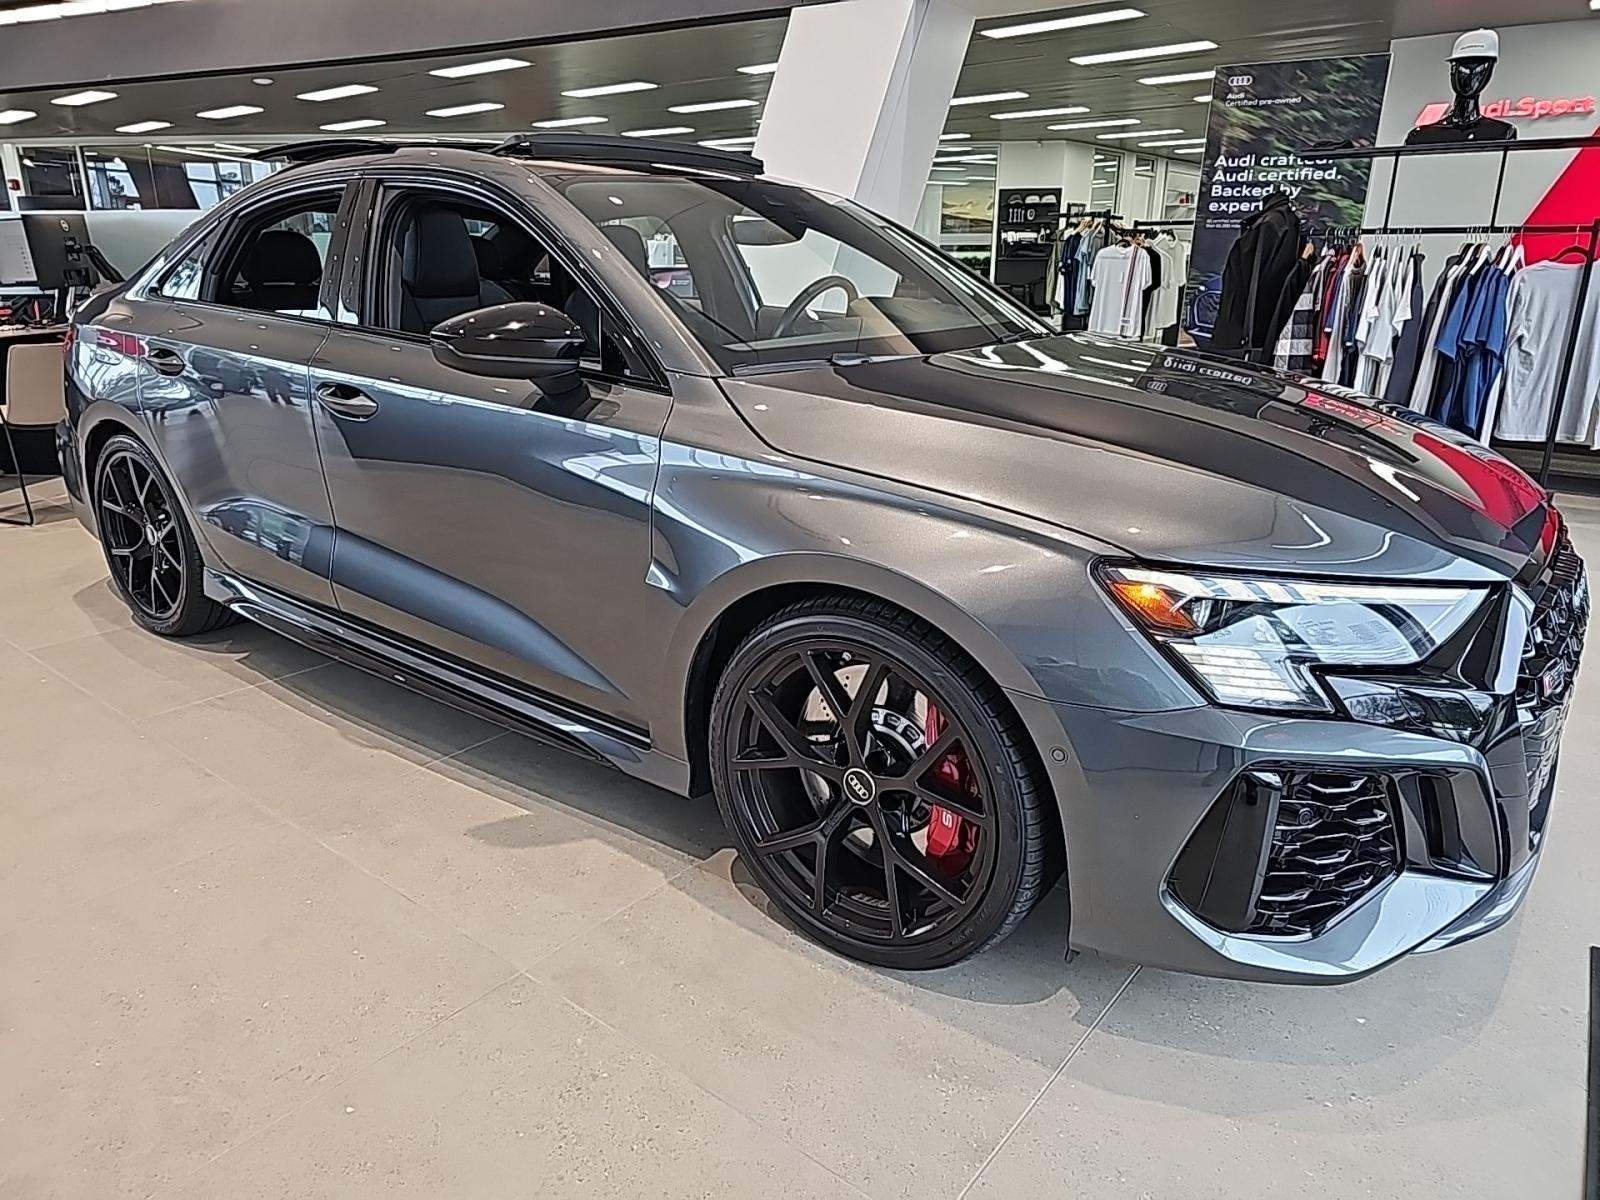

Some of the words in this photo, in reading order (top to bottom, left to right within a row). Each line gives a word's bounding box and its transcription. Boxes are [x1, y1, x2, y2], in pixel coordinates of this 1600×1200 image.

[1225, 99, 1258, 107] Certified
[1517, 97, 1596, 119] Sport
[1214, 154, 1256, 168] Audi
[1212, 169, 1253, 183] Audi
[1258, 167, 1342, 181] certified.
[1211, 184, 1275, 197] Backed
